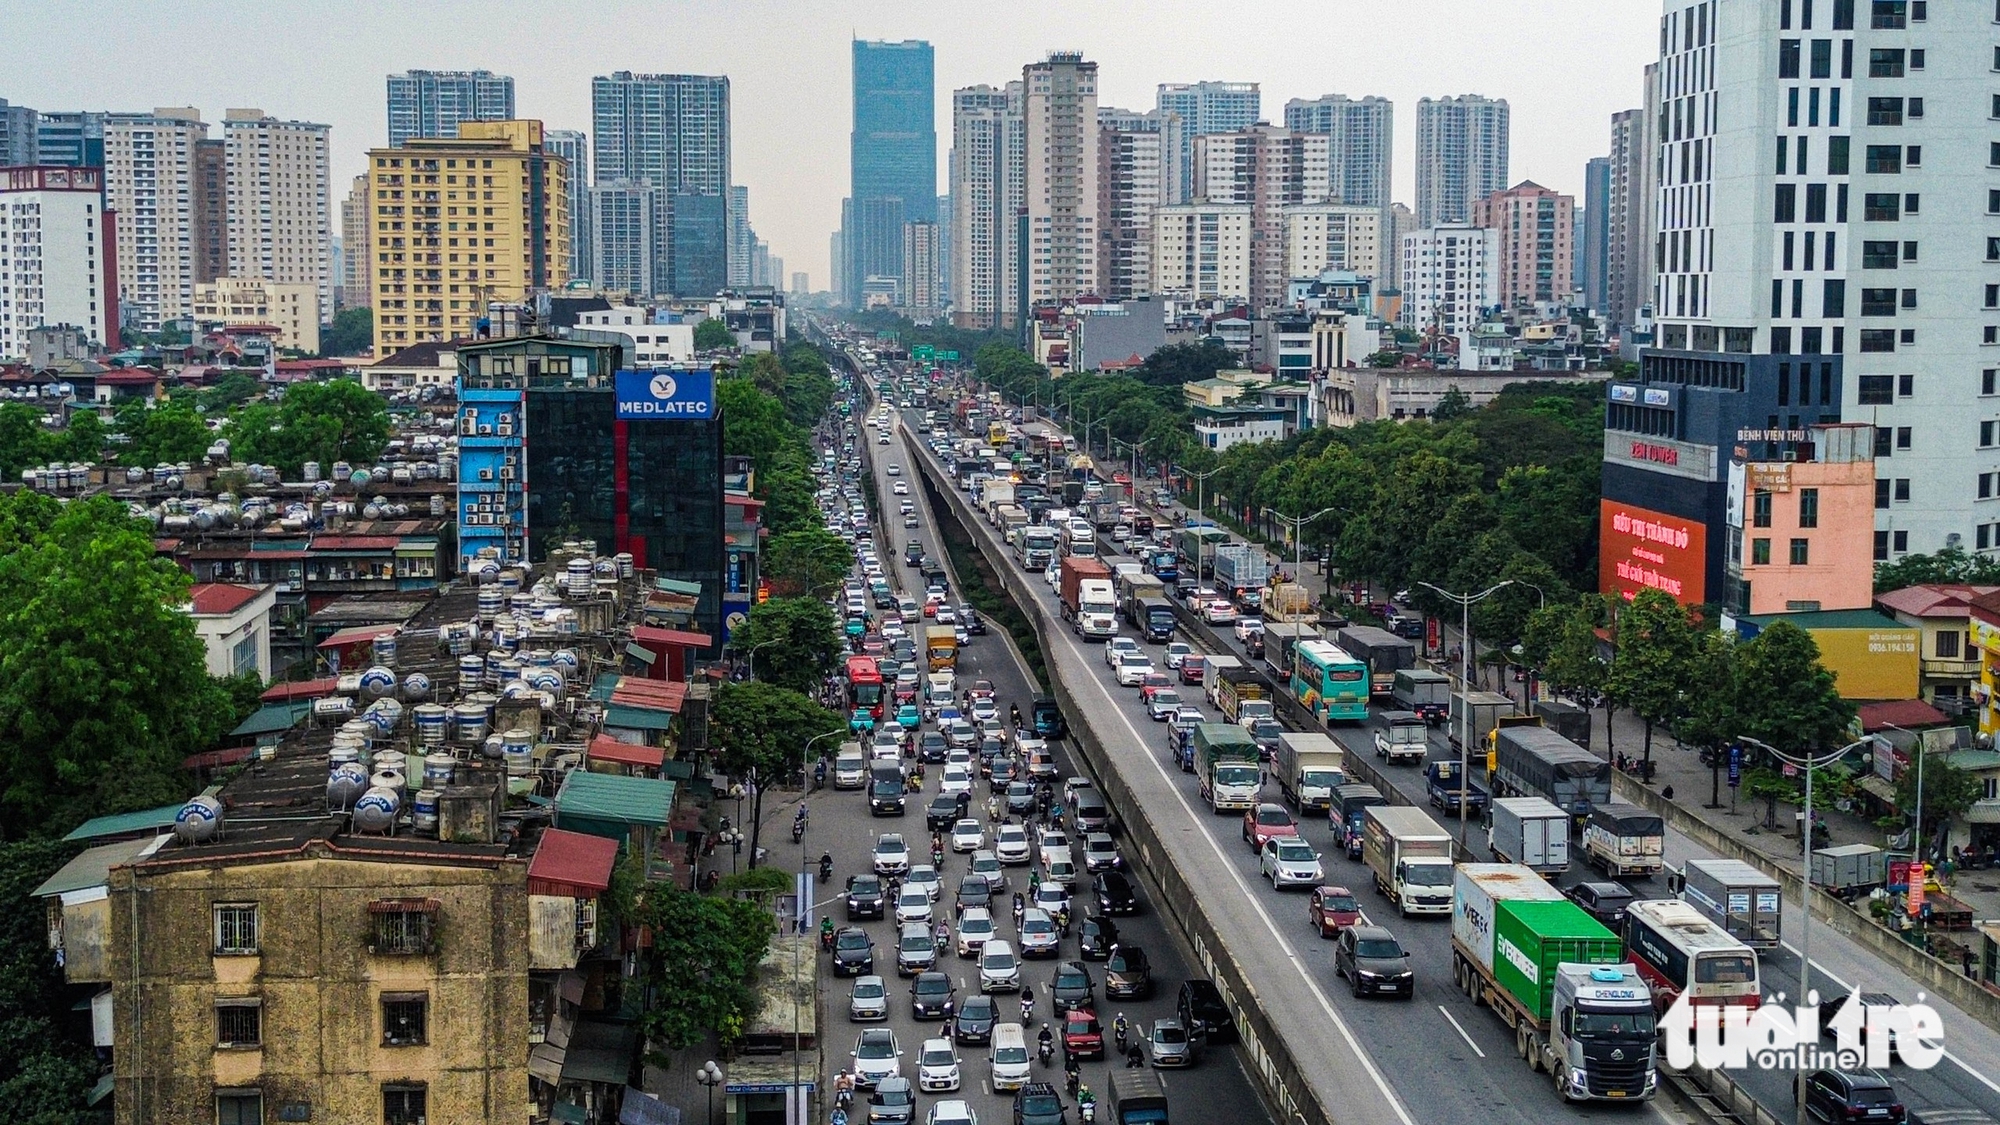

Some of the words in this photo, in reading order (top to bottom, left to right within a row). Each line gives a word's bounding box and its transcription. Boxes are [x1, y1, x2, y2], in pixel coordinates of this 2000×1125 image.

[620, 401, 708, 414] MEDLATEC
[1737, 425, 1762, 445] BỆNH
[1764, 426, 1785, 445] VIỆN
[1631, 442, 1647, 459] ZEN
[1648, 444, 1678, 466] TOWER
[1595, 990, 1635, 999] CHENGLONG
